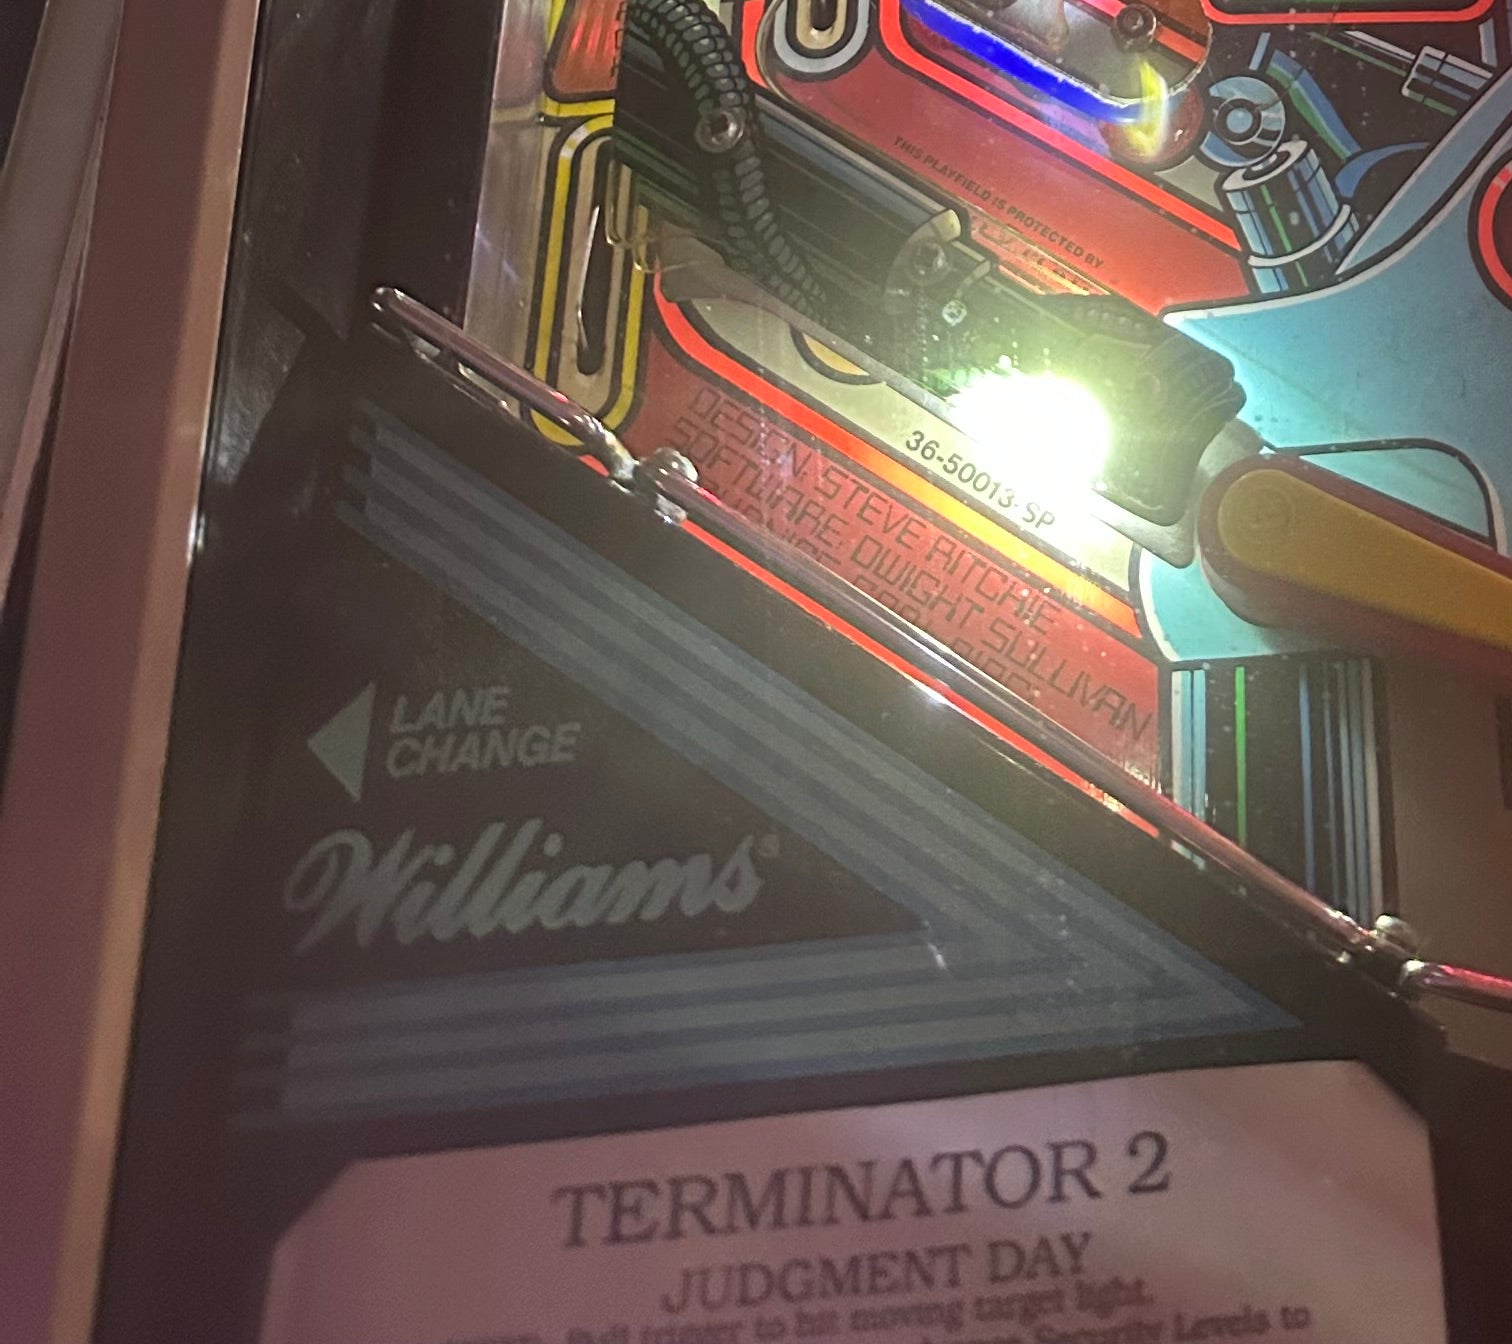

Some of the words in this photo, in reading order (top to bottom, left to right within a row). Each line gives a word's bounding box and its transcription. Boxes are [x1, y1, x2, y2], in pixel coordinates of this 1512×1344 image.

[893, 136, 923, 161] THIS
[923, 153, 992, 201] PLAYFIELD
[992, 196, 1007, 211] IS
[1006, 205, 1085, 258] PROTECTED
[1084, 253, 1105, 269] BY
[813, 466, 928, 553] STEVE
[924, 535, 1062, 636] RITCHIE
[850, 533, 986, 630] DWIGHT
[981, 619, 1153, 741] SULLIVAN
[386, 723, 582, 779] CHANGE
[389, 685, 514, 735] LANE
[282, 818, 765, 955] Williams
[550, 1140, 1105, 1250] TERMINATOR
[1126, 1131, 1175, 1194] 2
[660, 1244, 976, 1316] JUDGMENT
[985, 1231, 1096, 1280] DAY
